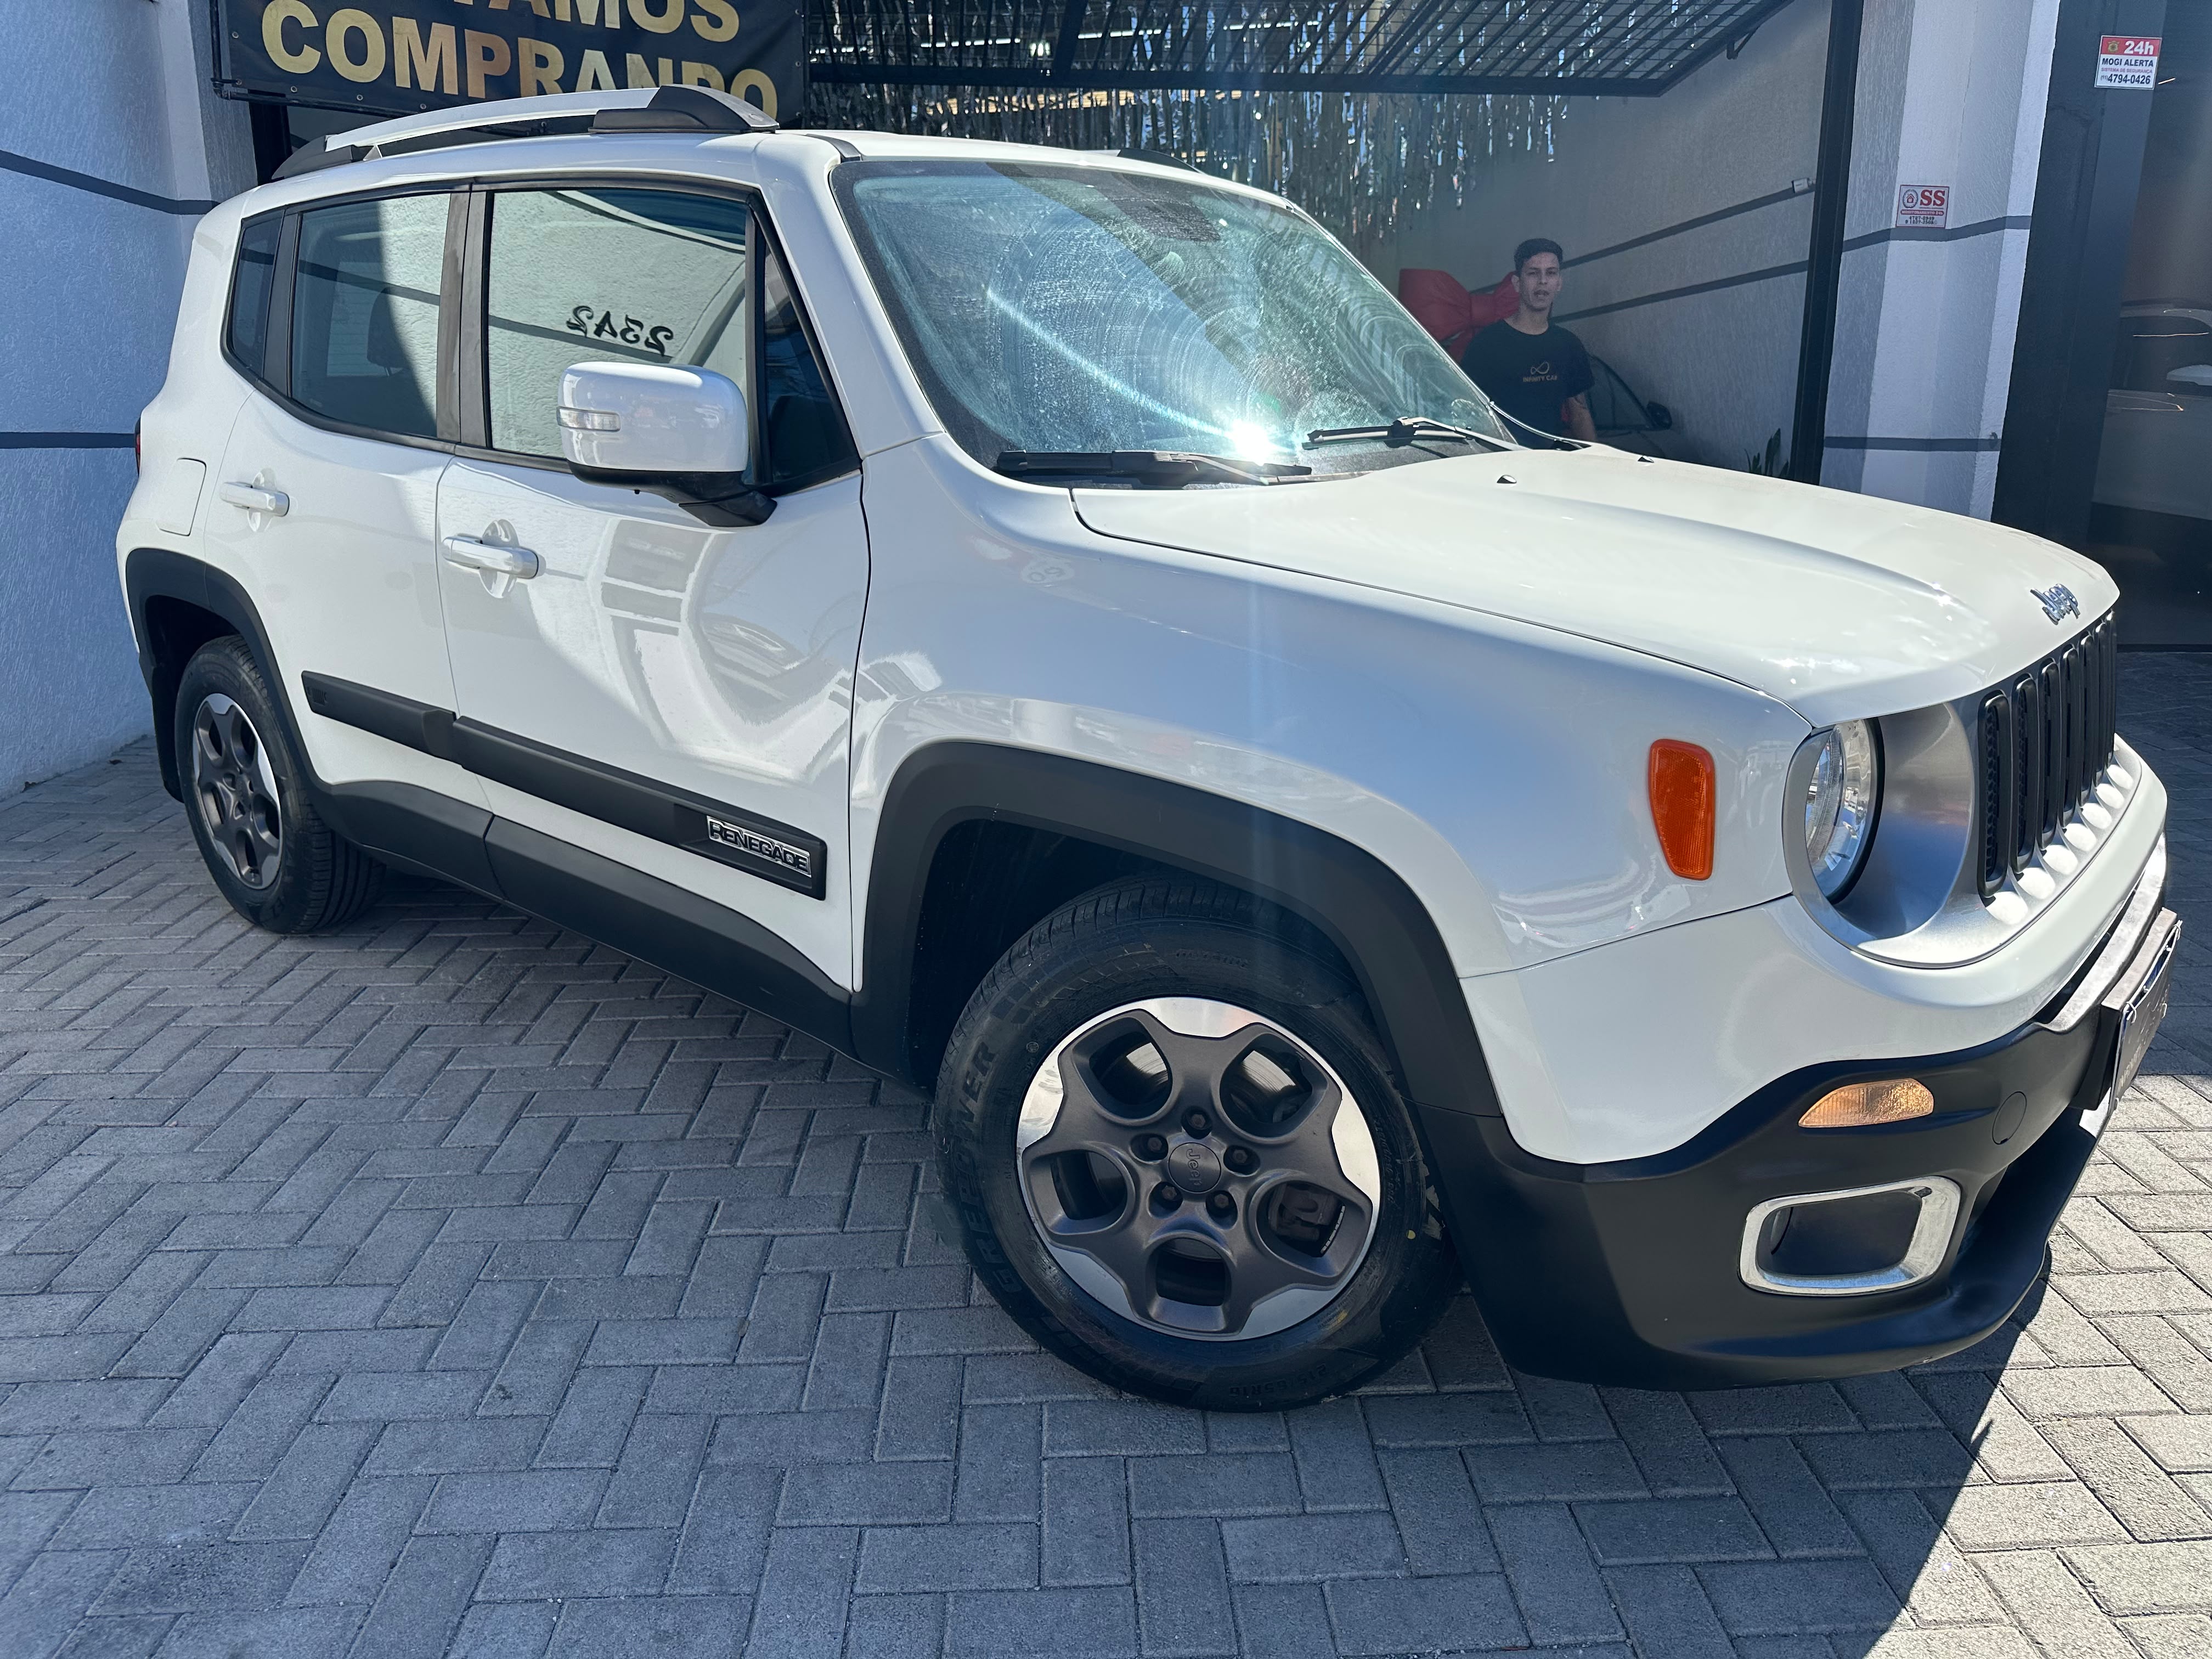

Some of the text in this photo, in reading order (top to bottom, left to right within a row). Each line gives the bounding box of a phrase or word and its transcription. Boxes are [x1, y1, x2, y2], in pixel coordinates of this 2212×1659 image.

[2124, 41, 2154, 55] 24h
[2102, 58, 2154, 67] MOGI ALERTA
[1920, 189, 1945, 206] SS
[707, 816, 812, 878] RENEGADE
[1186, 1148, 1201, 1186] Jeep
